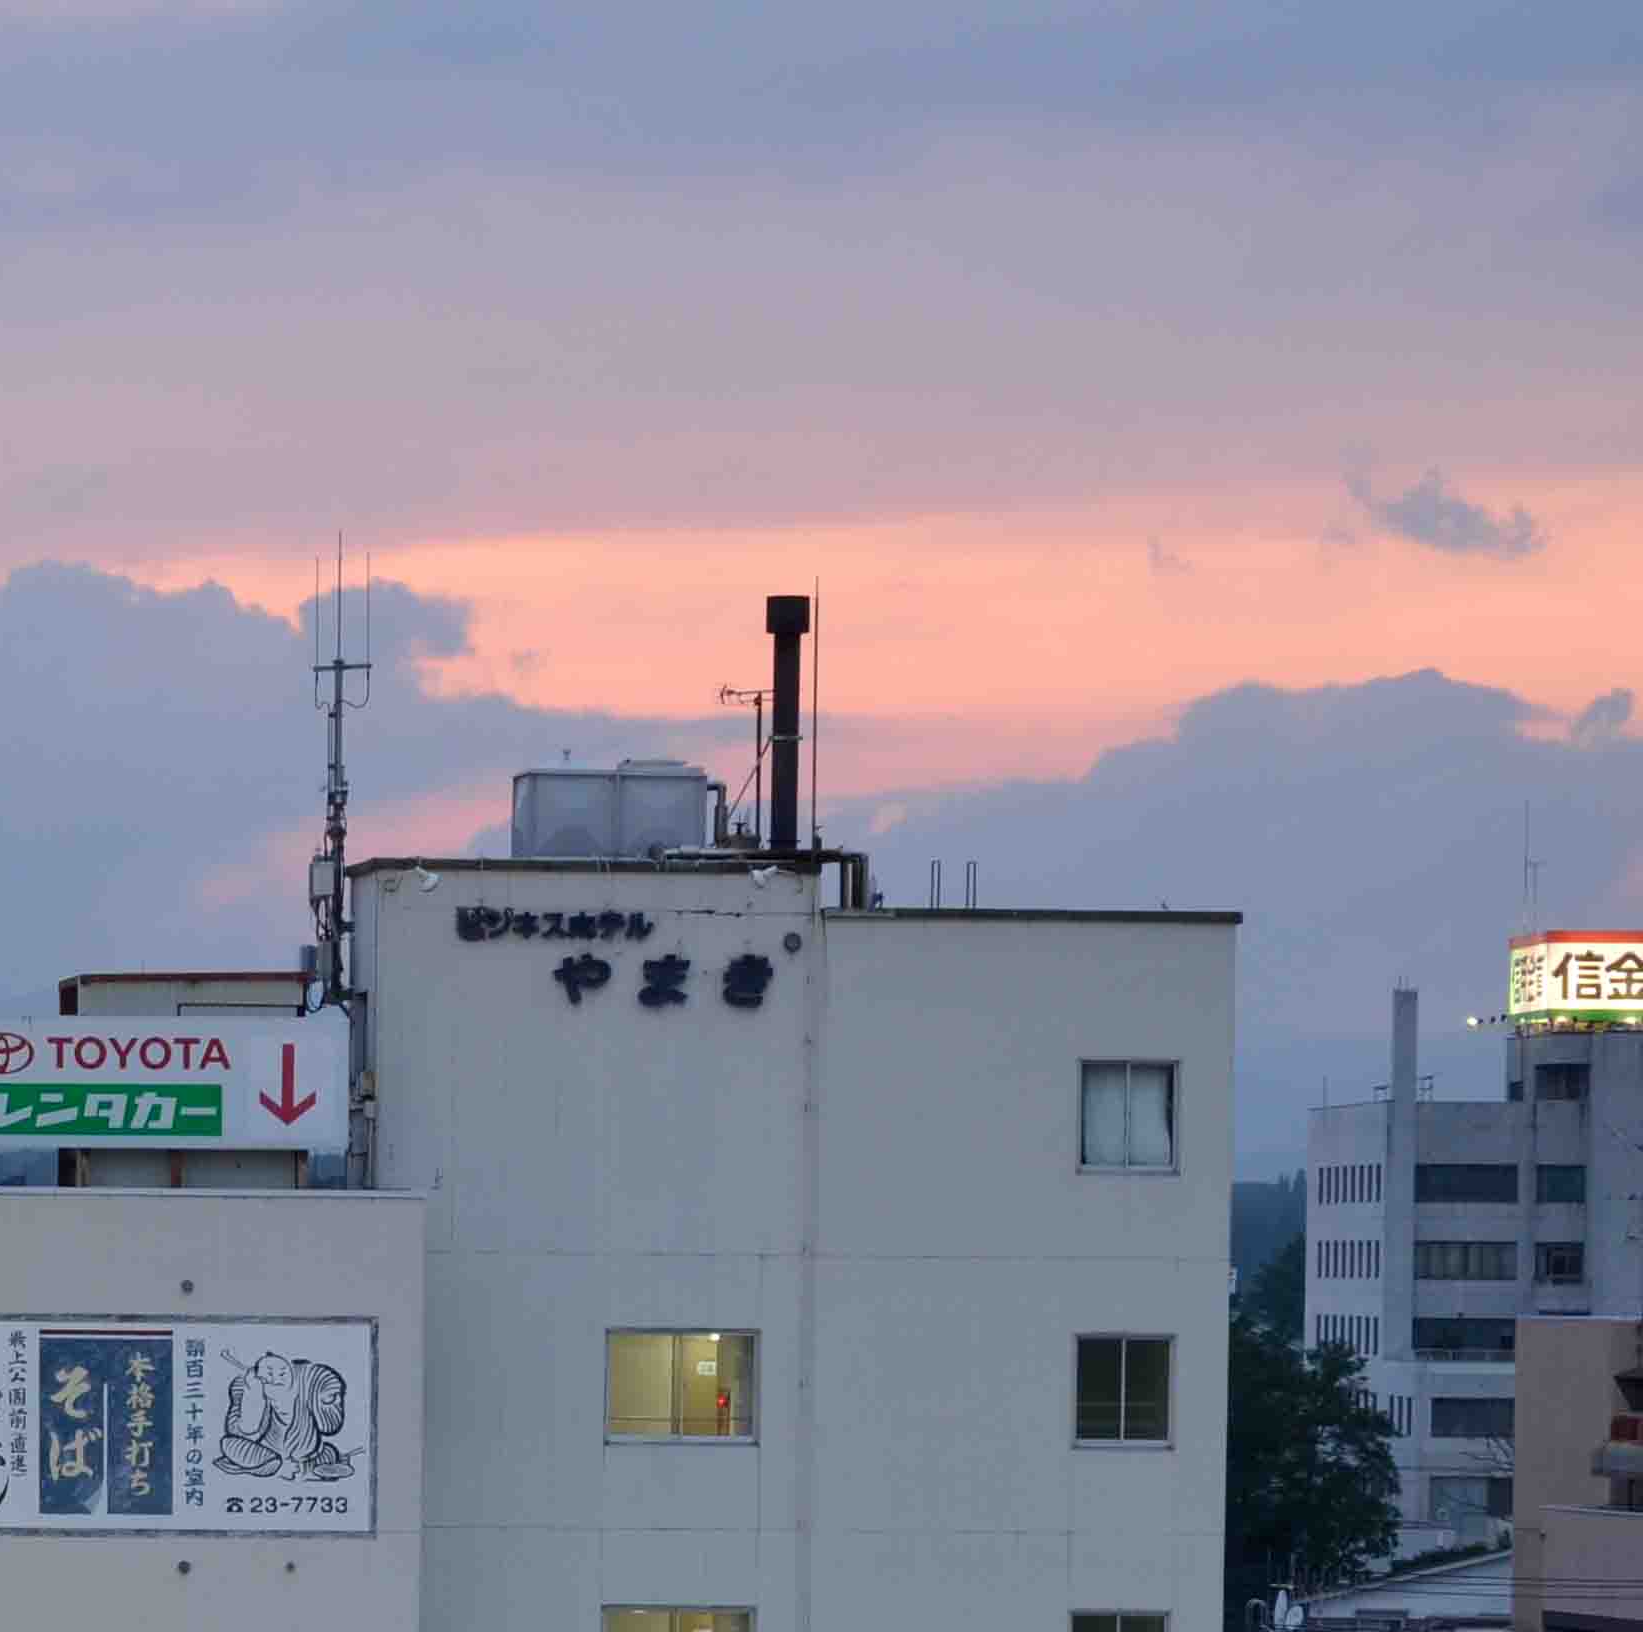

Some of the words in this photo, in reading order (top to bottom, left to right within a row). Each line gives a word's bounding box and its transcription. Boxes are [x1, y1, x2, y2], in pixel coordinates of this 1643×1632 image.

[552, 953, 773, 1008] やまき
[47, 1036, 231, 1070] TOYOTA
[50, 1365, 103, 1484] そば
[123, 1351, 156, 1496] 本格手打ち
[250, 1496, 348, 1514] 23-7733
